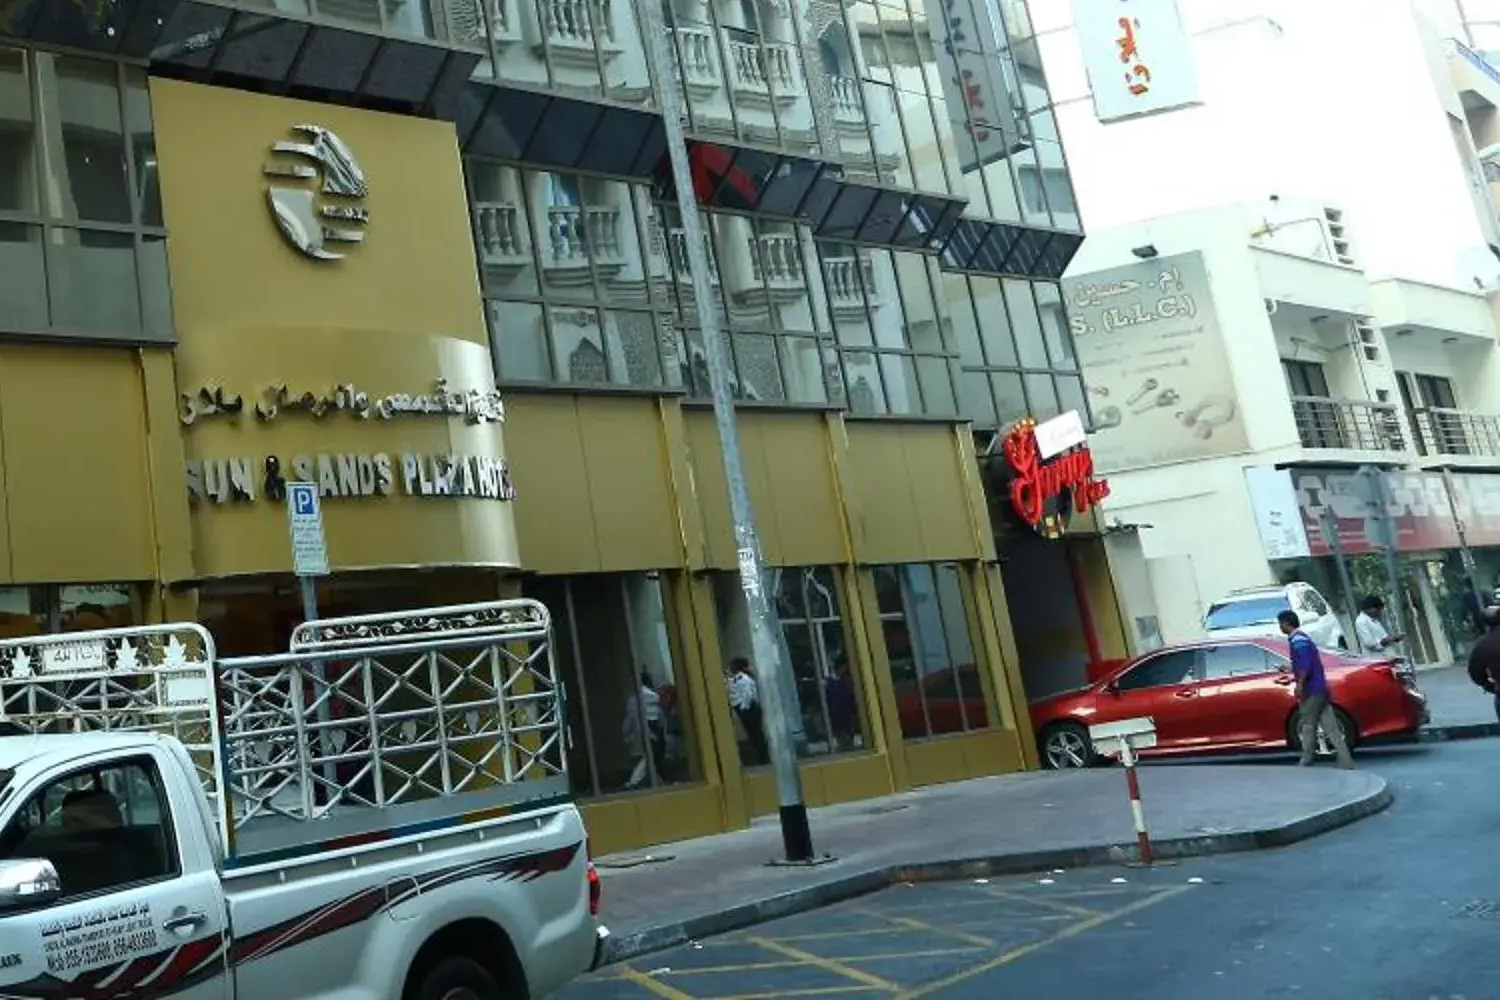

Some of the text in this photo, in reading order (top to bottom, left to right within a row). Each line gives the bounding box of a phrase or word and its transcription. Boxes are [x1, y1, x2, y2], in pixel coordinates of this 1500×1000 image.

[1114, 16, 1151, 96] بلازا
[186, 456, 256, 503] SUN
[292, 452, 393, 498] SANDS
